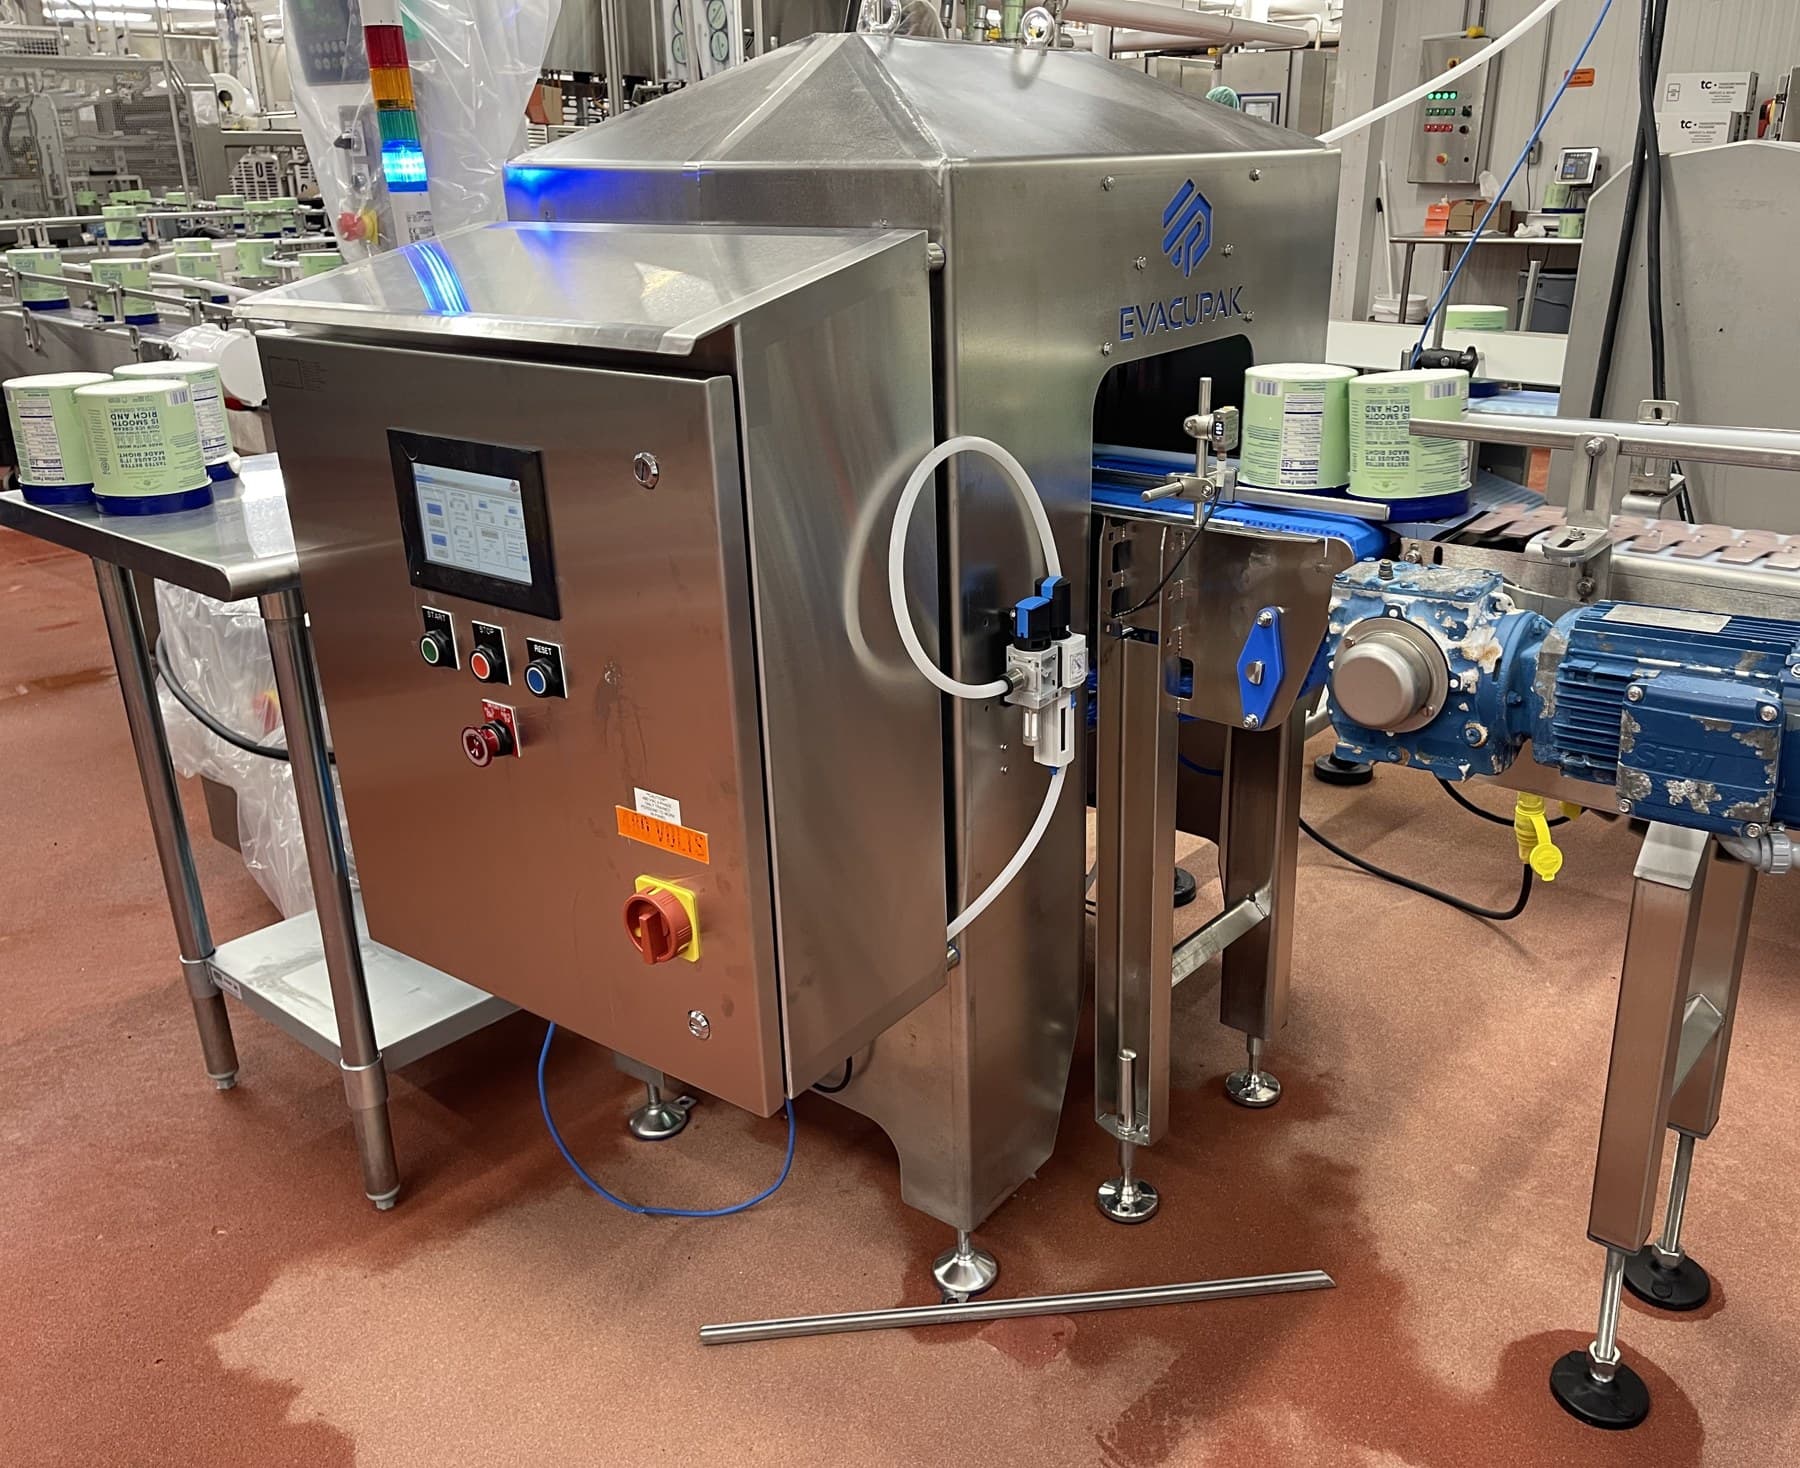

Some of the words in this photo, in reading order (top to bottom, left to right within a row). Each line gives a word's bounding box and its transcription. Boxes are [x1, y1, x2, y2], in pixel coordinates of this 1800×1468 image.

[1700, 80, 1713, 89] tc
[1680, 119, 1693, 129] tc
[1119, 285, 1243, 341] EVACUPAK
[1365, 405, 1383, 413] AND
[1385, 405, 1410, 413] RICH
[110, 413, 130, 421] AND
[133, 411, 158, 420] RICH
[427, 610, 446, 622] START
[479, 625, 495, 636] STOP
[533, 643, 552, 656] RESET
